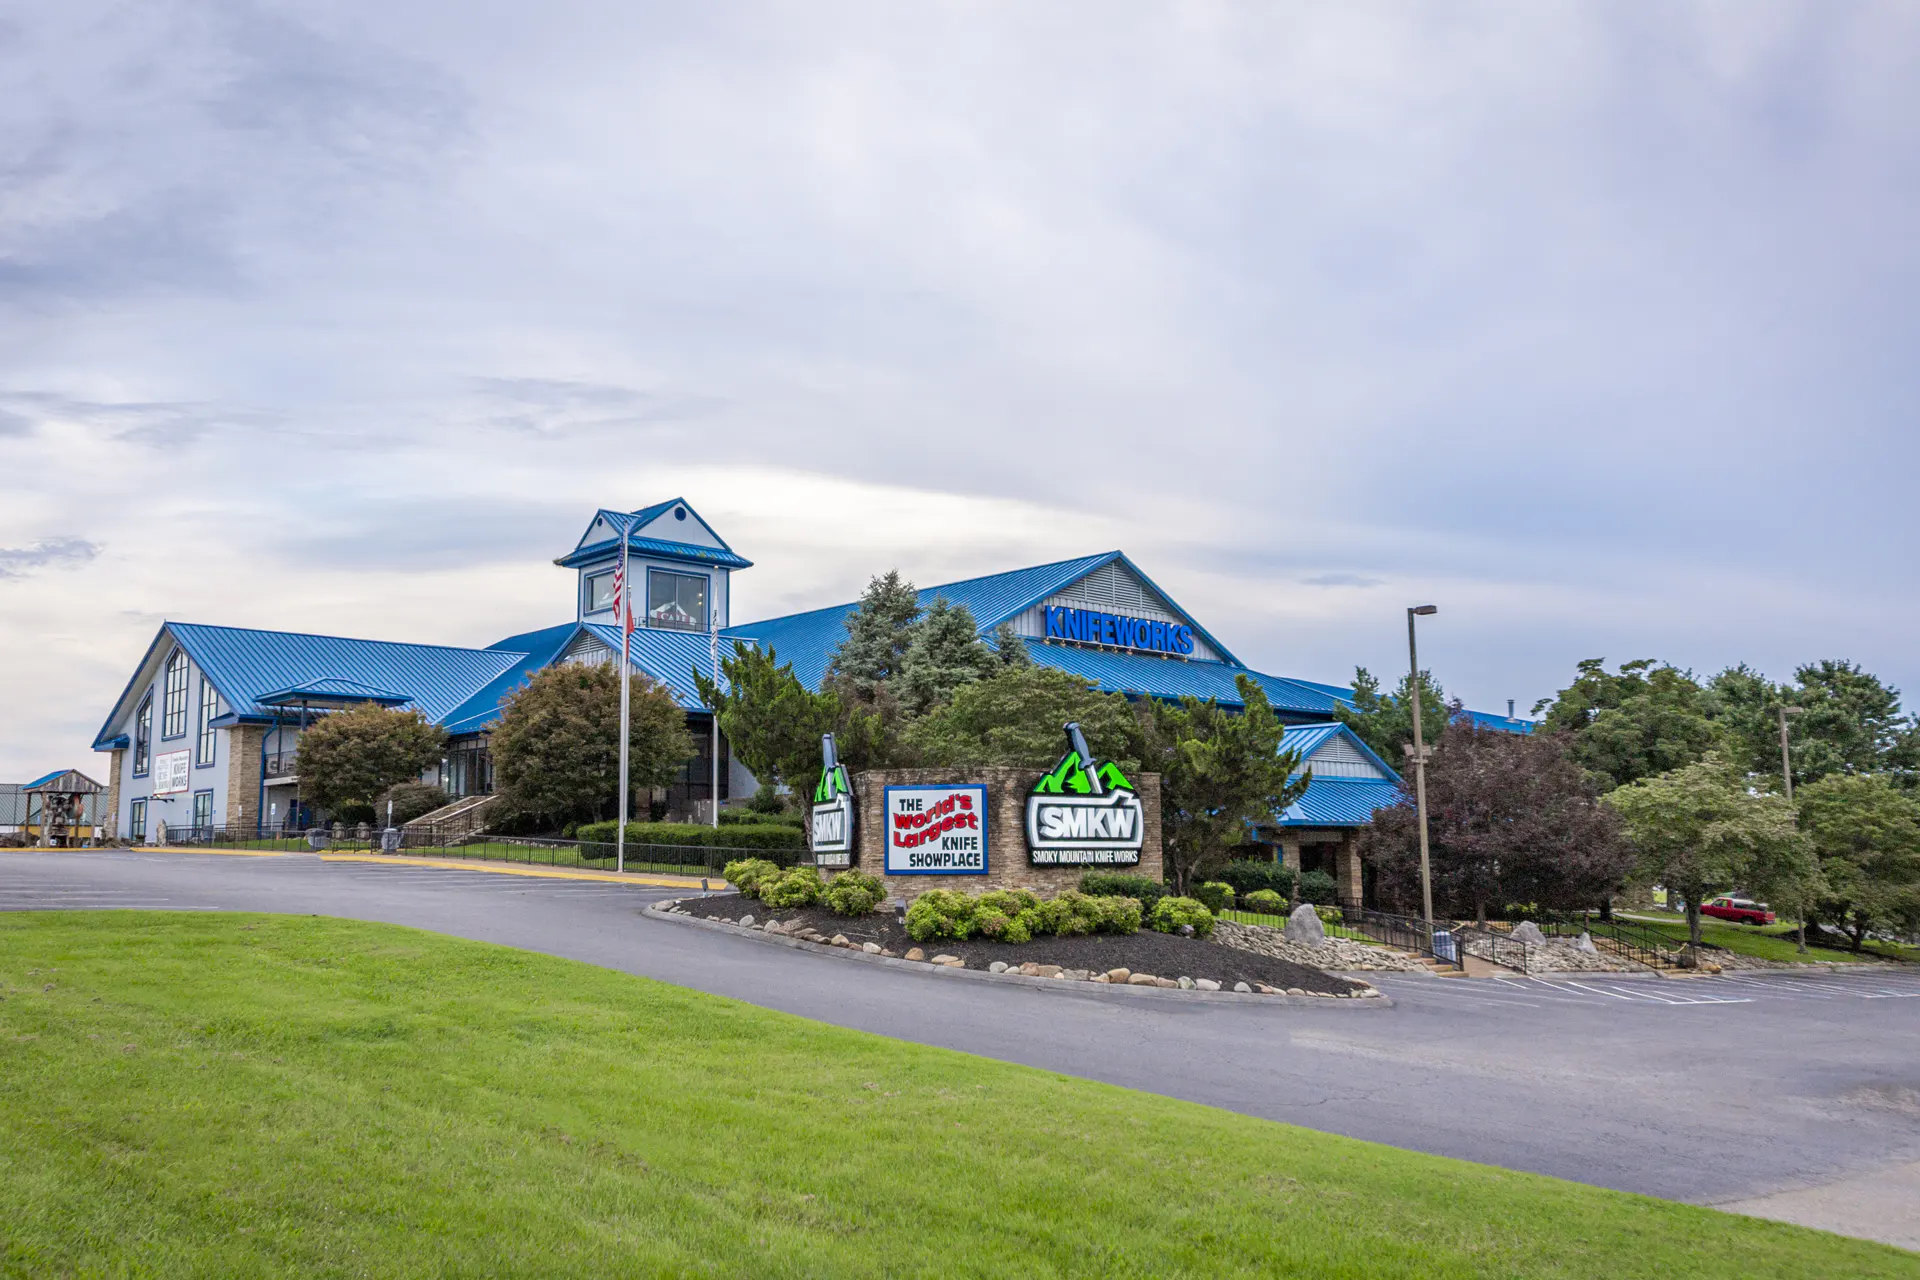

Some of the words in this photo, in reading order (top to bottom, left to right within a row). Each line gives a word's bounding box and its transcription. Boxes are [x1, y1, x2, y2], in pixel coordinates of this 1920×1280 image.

[1045, 605, 1194, 654] KNIFEWORKS
[899, 798, 922, 812] THE
[814, 811, 842, 843] SMKW
[1040, 806, 1135, 838] SMKW
[942, 836, 978, 850] KNIFE
[909, 852, 981, 867] SHOWPLACE
[1033, 850, 1058, 862] SMOKY
[1059, 850, 1094, 863] MOUNTAIN
[1095, 850, 1114, 862] KNIFE
[1114, 850, 1138, 862] WORKS
